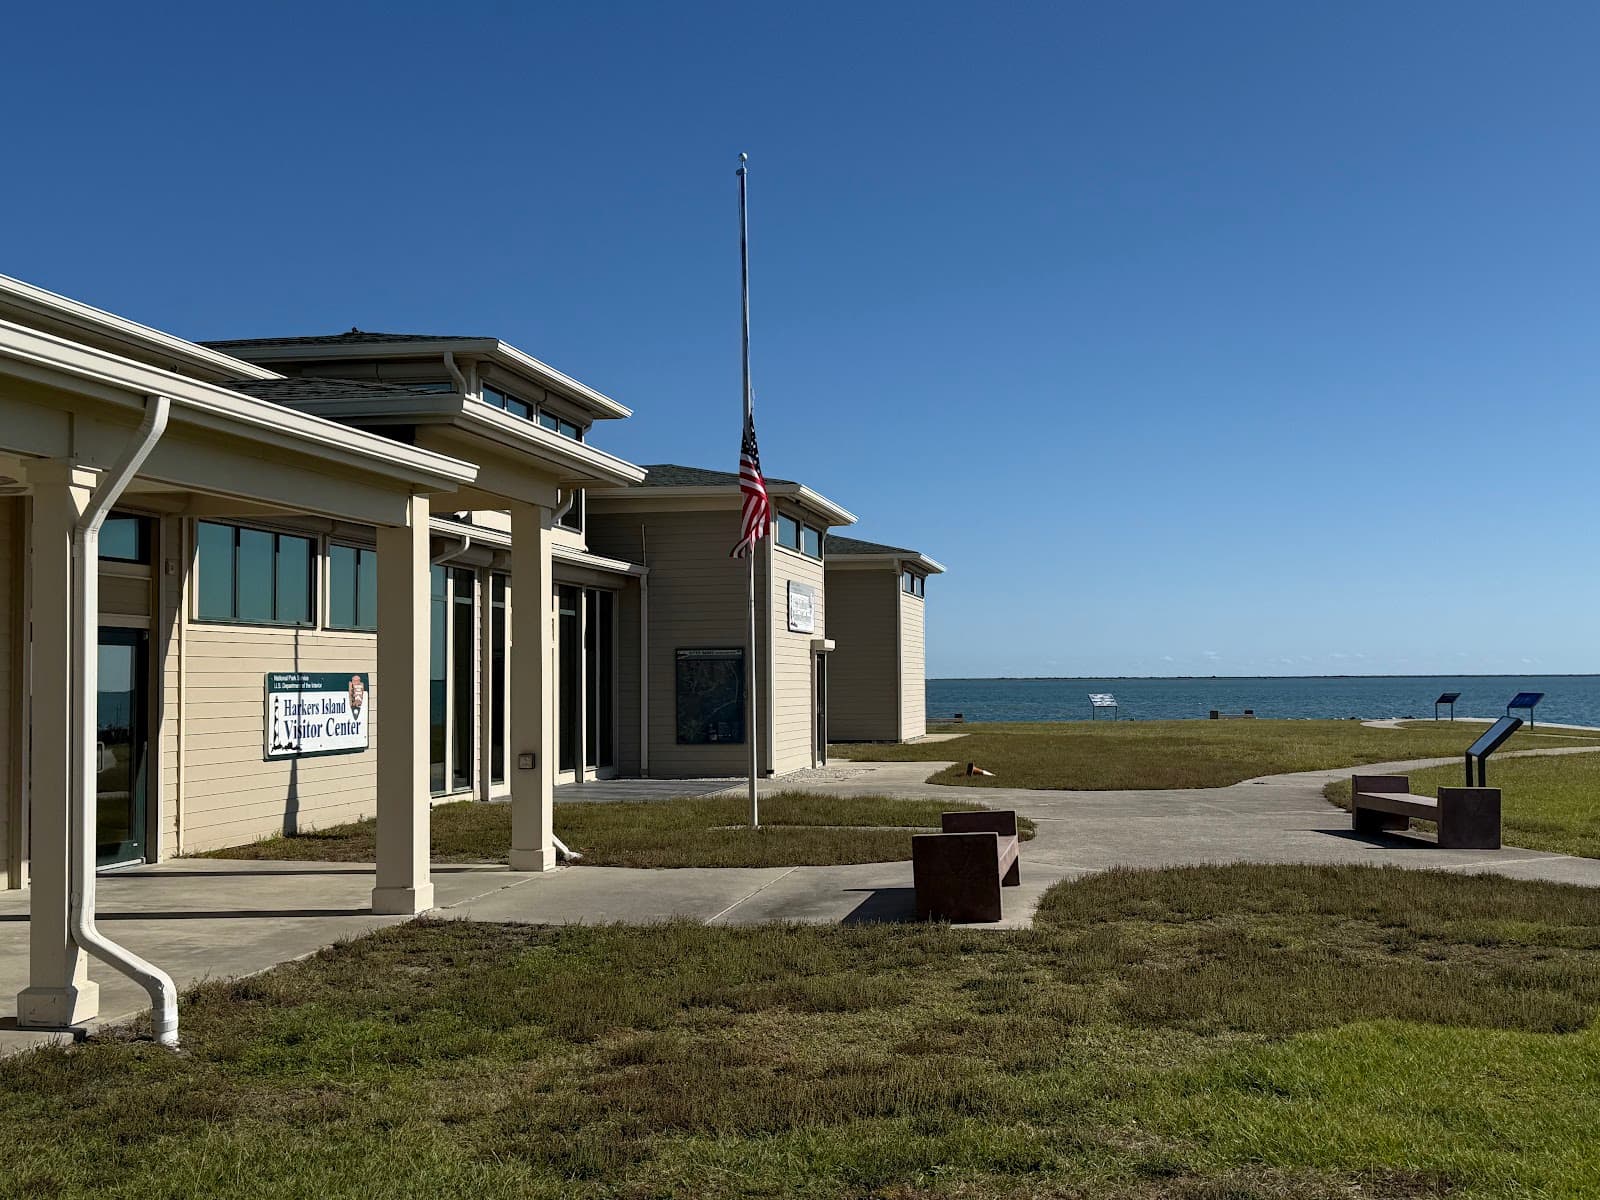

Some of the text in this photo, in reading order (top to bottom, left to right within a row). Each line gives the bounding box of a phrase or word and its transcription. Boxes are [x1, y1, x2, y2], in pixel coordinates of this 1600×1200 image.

[282, 682, 301, 690] Departmen
[284, 698, 346, 716] Harkers Island
[284, 718, 361, 740] Visitor Center
